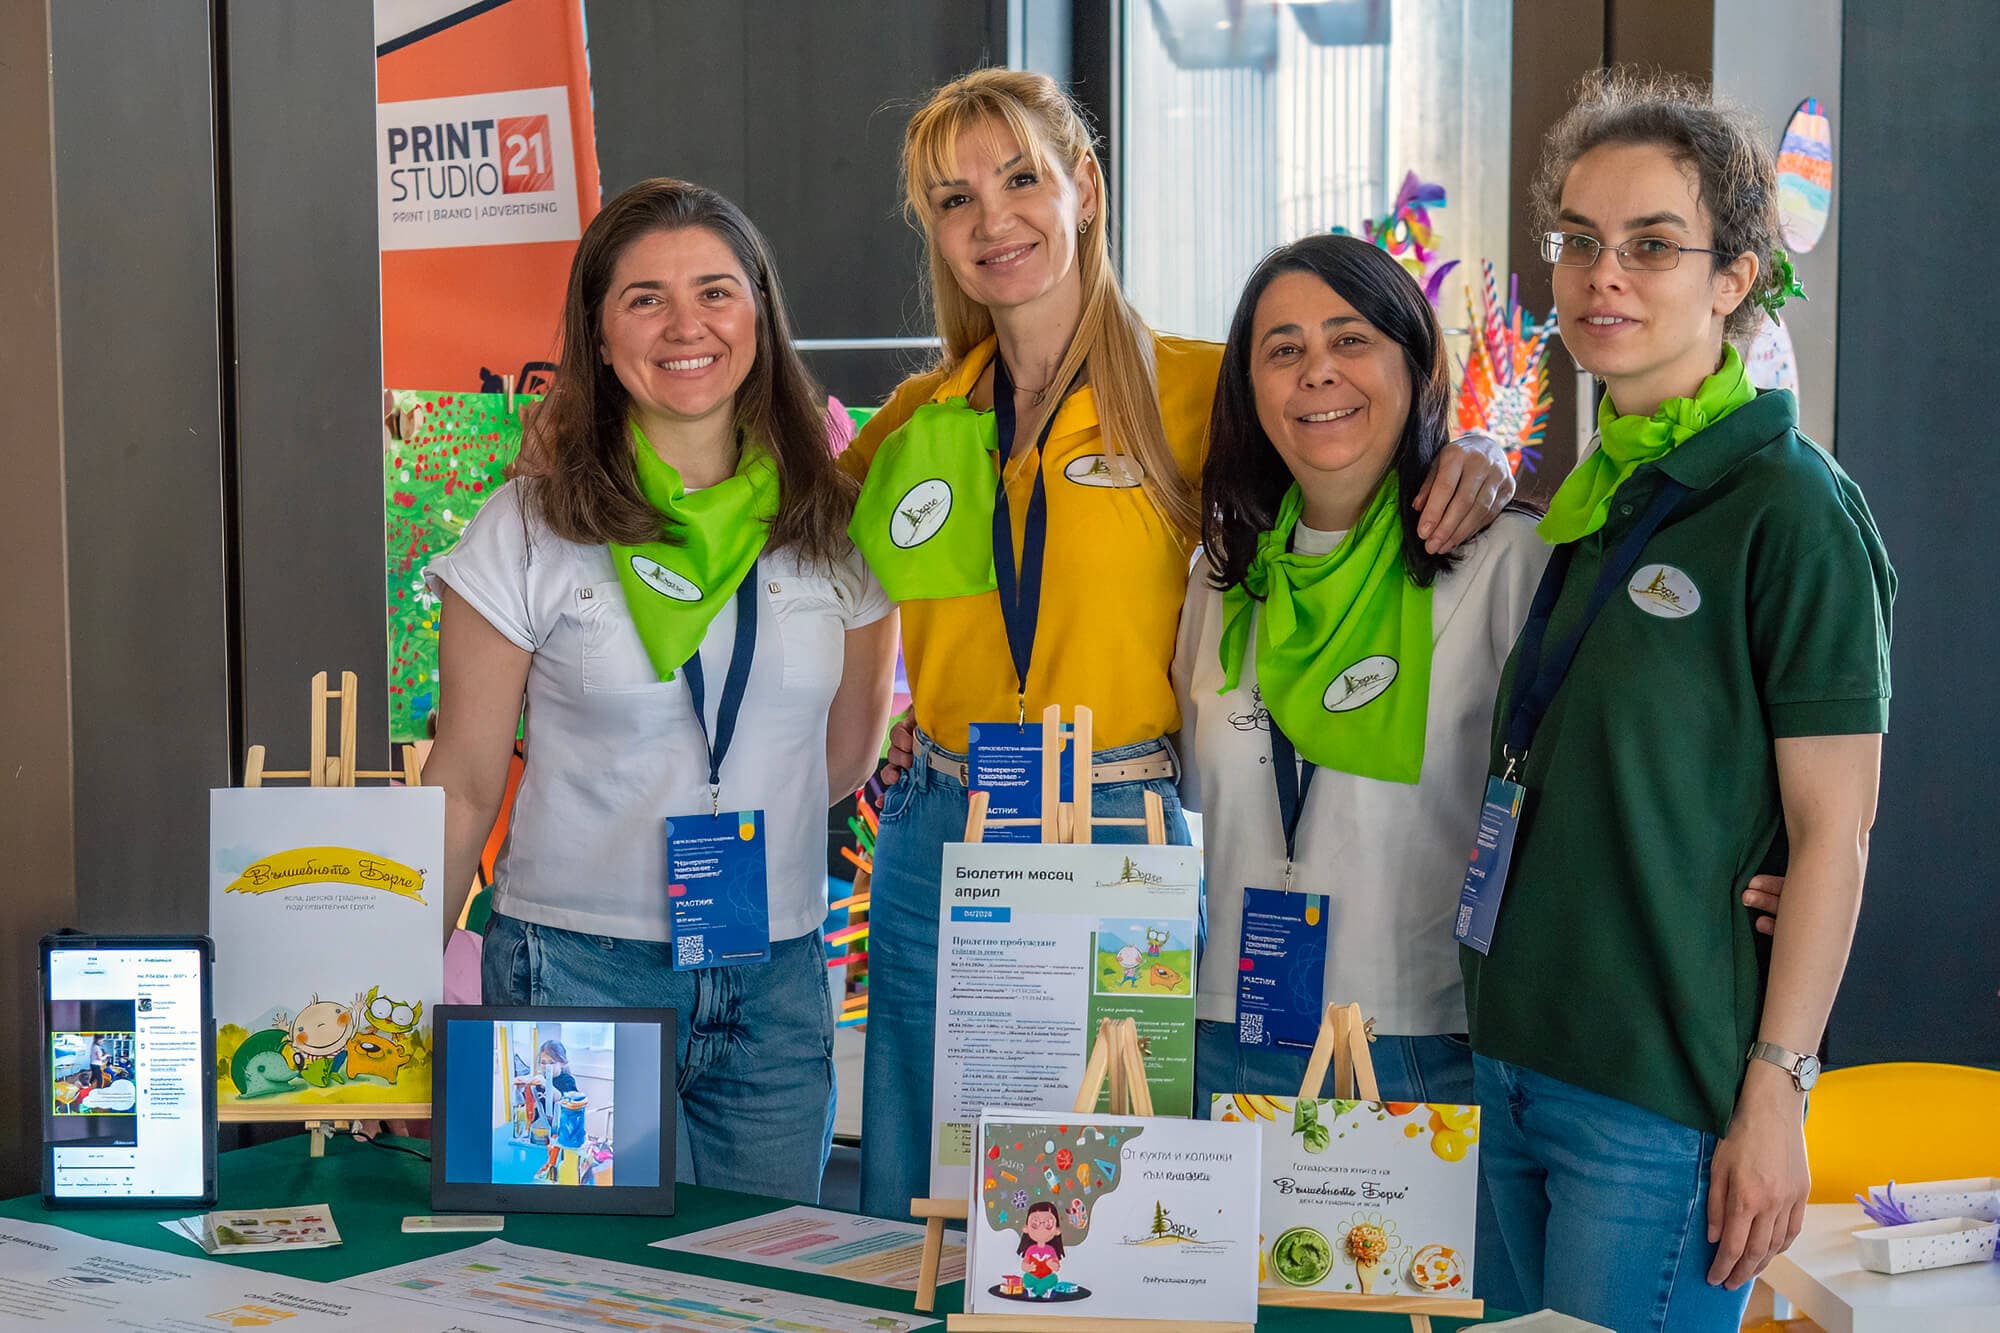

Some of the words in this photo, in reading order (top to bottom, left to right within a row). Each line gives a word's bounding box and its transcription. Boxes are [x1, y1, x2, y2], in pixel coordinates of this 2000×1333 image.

[387, 119, 495, 165] PRINT
[505, 132, 547, 177] 21
[390, 162, 499, 202] STUDIO
[393, 210, 424, 223] PRINT
[433, 207, 472, 221] BRAND
[481, 202, 558, 217] ADVERTISING
[987, 807, 1019, 815] АСТНИК
[955, 866, 1024, 882] Бюлетин
[1027, 869, 1074, 883] месец
[954, 886, 1001, 900] април
[952, 936, 998, 947] Пролетно
[1000, 938, 1057, 948] пробуждане
[1121, 1148, 1136, 1160] От
[1174, 1152, 1182, 1161] и
[1350, 1167, 1377, 1175] книга
